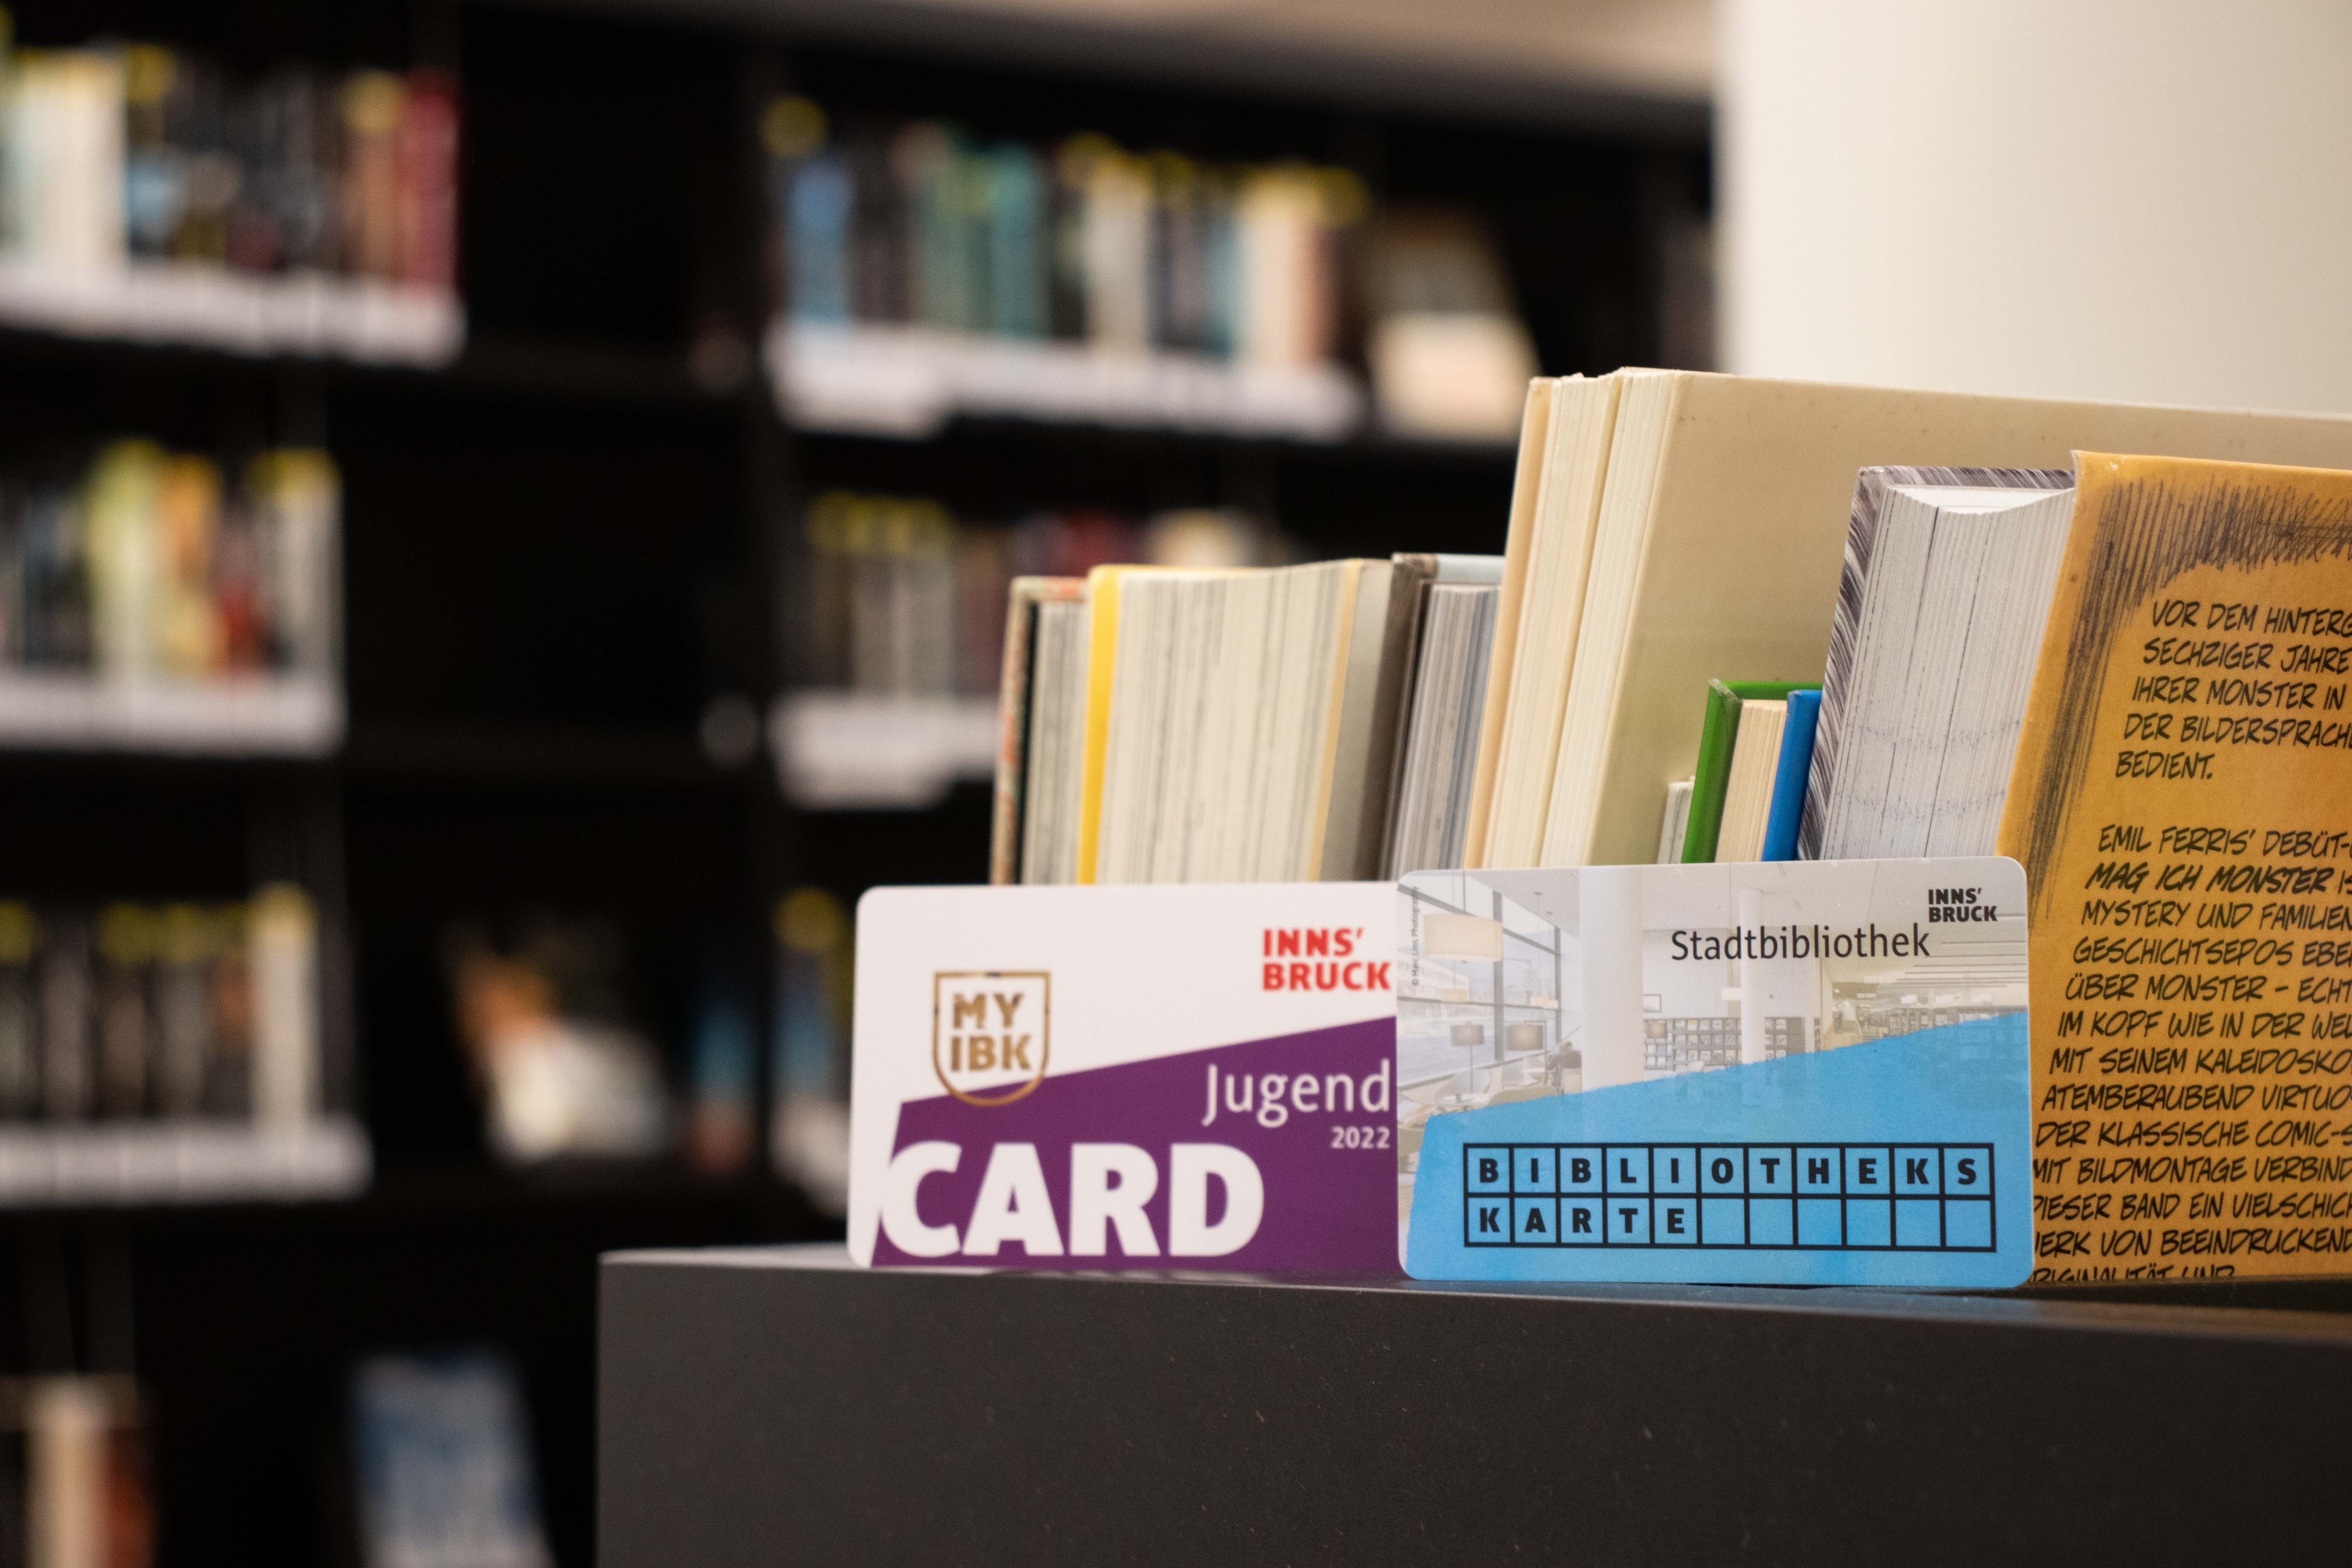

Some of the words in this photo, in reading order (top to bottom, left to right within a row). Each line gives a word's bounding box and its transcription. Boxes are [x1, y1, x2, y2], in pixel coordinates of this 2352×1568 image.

[2153, 599, 2200, 627] VOR
[2207, 603, 2258, 631] DEM
[2143, 637, 2274, 670] SECHZIGER
[2281, 644, 2352, 674] JAHRE
[2132, 676, 2200, 704] IHRER
[2207, 679, 2317, 709] MONSTER
[2323, 684, 2347, 710] IN
[2124, 713, 2173, 740] DER
[2181, 716, 2352, 749] BILDERSPRACH
[2116, 750, 2214, 779] BEDIENT.
[2098, 824, 2151, 852] EMIL
[2159, 826, 2256, 855] FERRIS'
[2263, 831, 2352, 858] DEBÜT-
[2085, 862, 2149, 894] MAG
[2155, 864, 2203, 891] ICH
[2206, 865, 2334, 894] MONSTER
[1929, 888, 1981, 904] INNS'
[1929, 906, 1997, 922] BRUCK
[2082, 899, 2190, 927] MYSTERY
[2197, 902, 2253, 929] UND
[1264, 929, 1361, 956] INNS'
[1672, 923, 1929, 960] Stadtbibliothek
[2074, 936, 2294, 966] GESCHICHTSEPOS
[2302, 941, 2352, 967] EBE
[1263, 962, 1389, 990] BRUCK
[2066, 973, 2139, 1000] ÜBER
[2145, 975, 2267, 1002] MONSTER
[953, 993, 1022, 1029] MY
[2058, 1011, 2083, 1037] IM
[2091, 1010, 2162, 1038] KOPF
[2168, 1012, 2214, 1038] WIE
[2220, 1012, 2243, 1038] IN
[2251, 1013, 2305, 1038] DER
[951, 1035, 1030, 1072] IBK
[2049, 1047, 2093, 1074] MIT
[2099, 1047, 2187, 1074] SEINEM
[1203, 1059, 1389, 1127] Jugend
[2042, 1083, 2254, 1111] ATEMBERAUBEND
[1332, 1127, 1389, 1148] 2022
[2036, 1121, 2091, 1147] DER
[2098, 1121, 2249, 1147] KLASSISCHE
[1479, 1157, 1976, 1186] BIBLIOTHEKS
[2078, 1156, 2247, 1185] BILDMONTAGE
[880, 1140, 1264, 1258] CARD
[2120, 1193, 2180, 1220] BAND
[2189, 1192, 2224, 1219] EIN
[1479, 1207, 1686, 1234] KARTE
[2035, 1231, 2091, 1258] ERK
[2101, 1229, 2152, 1256] VON
